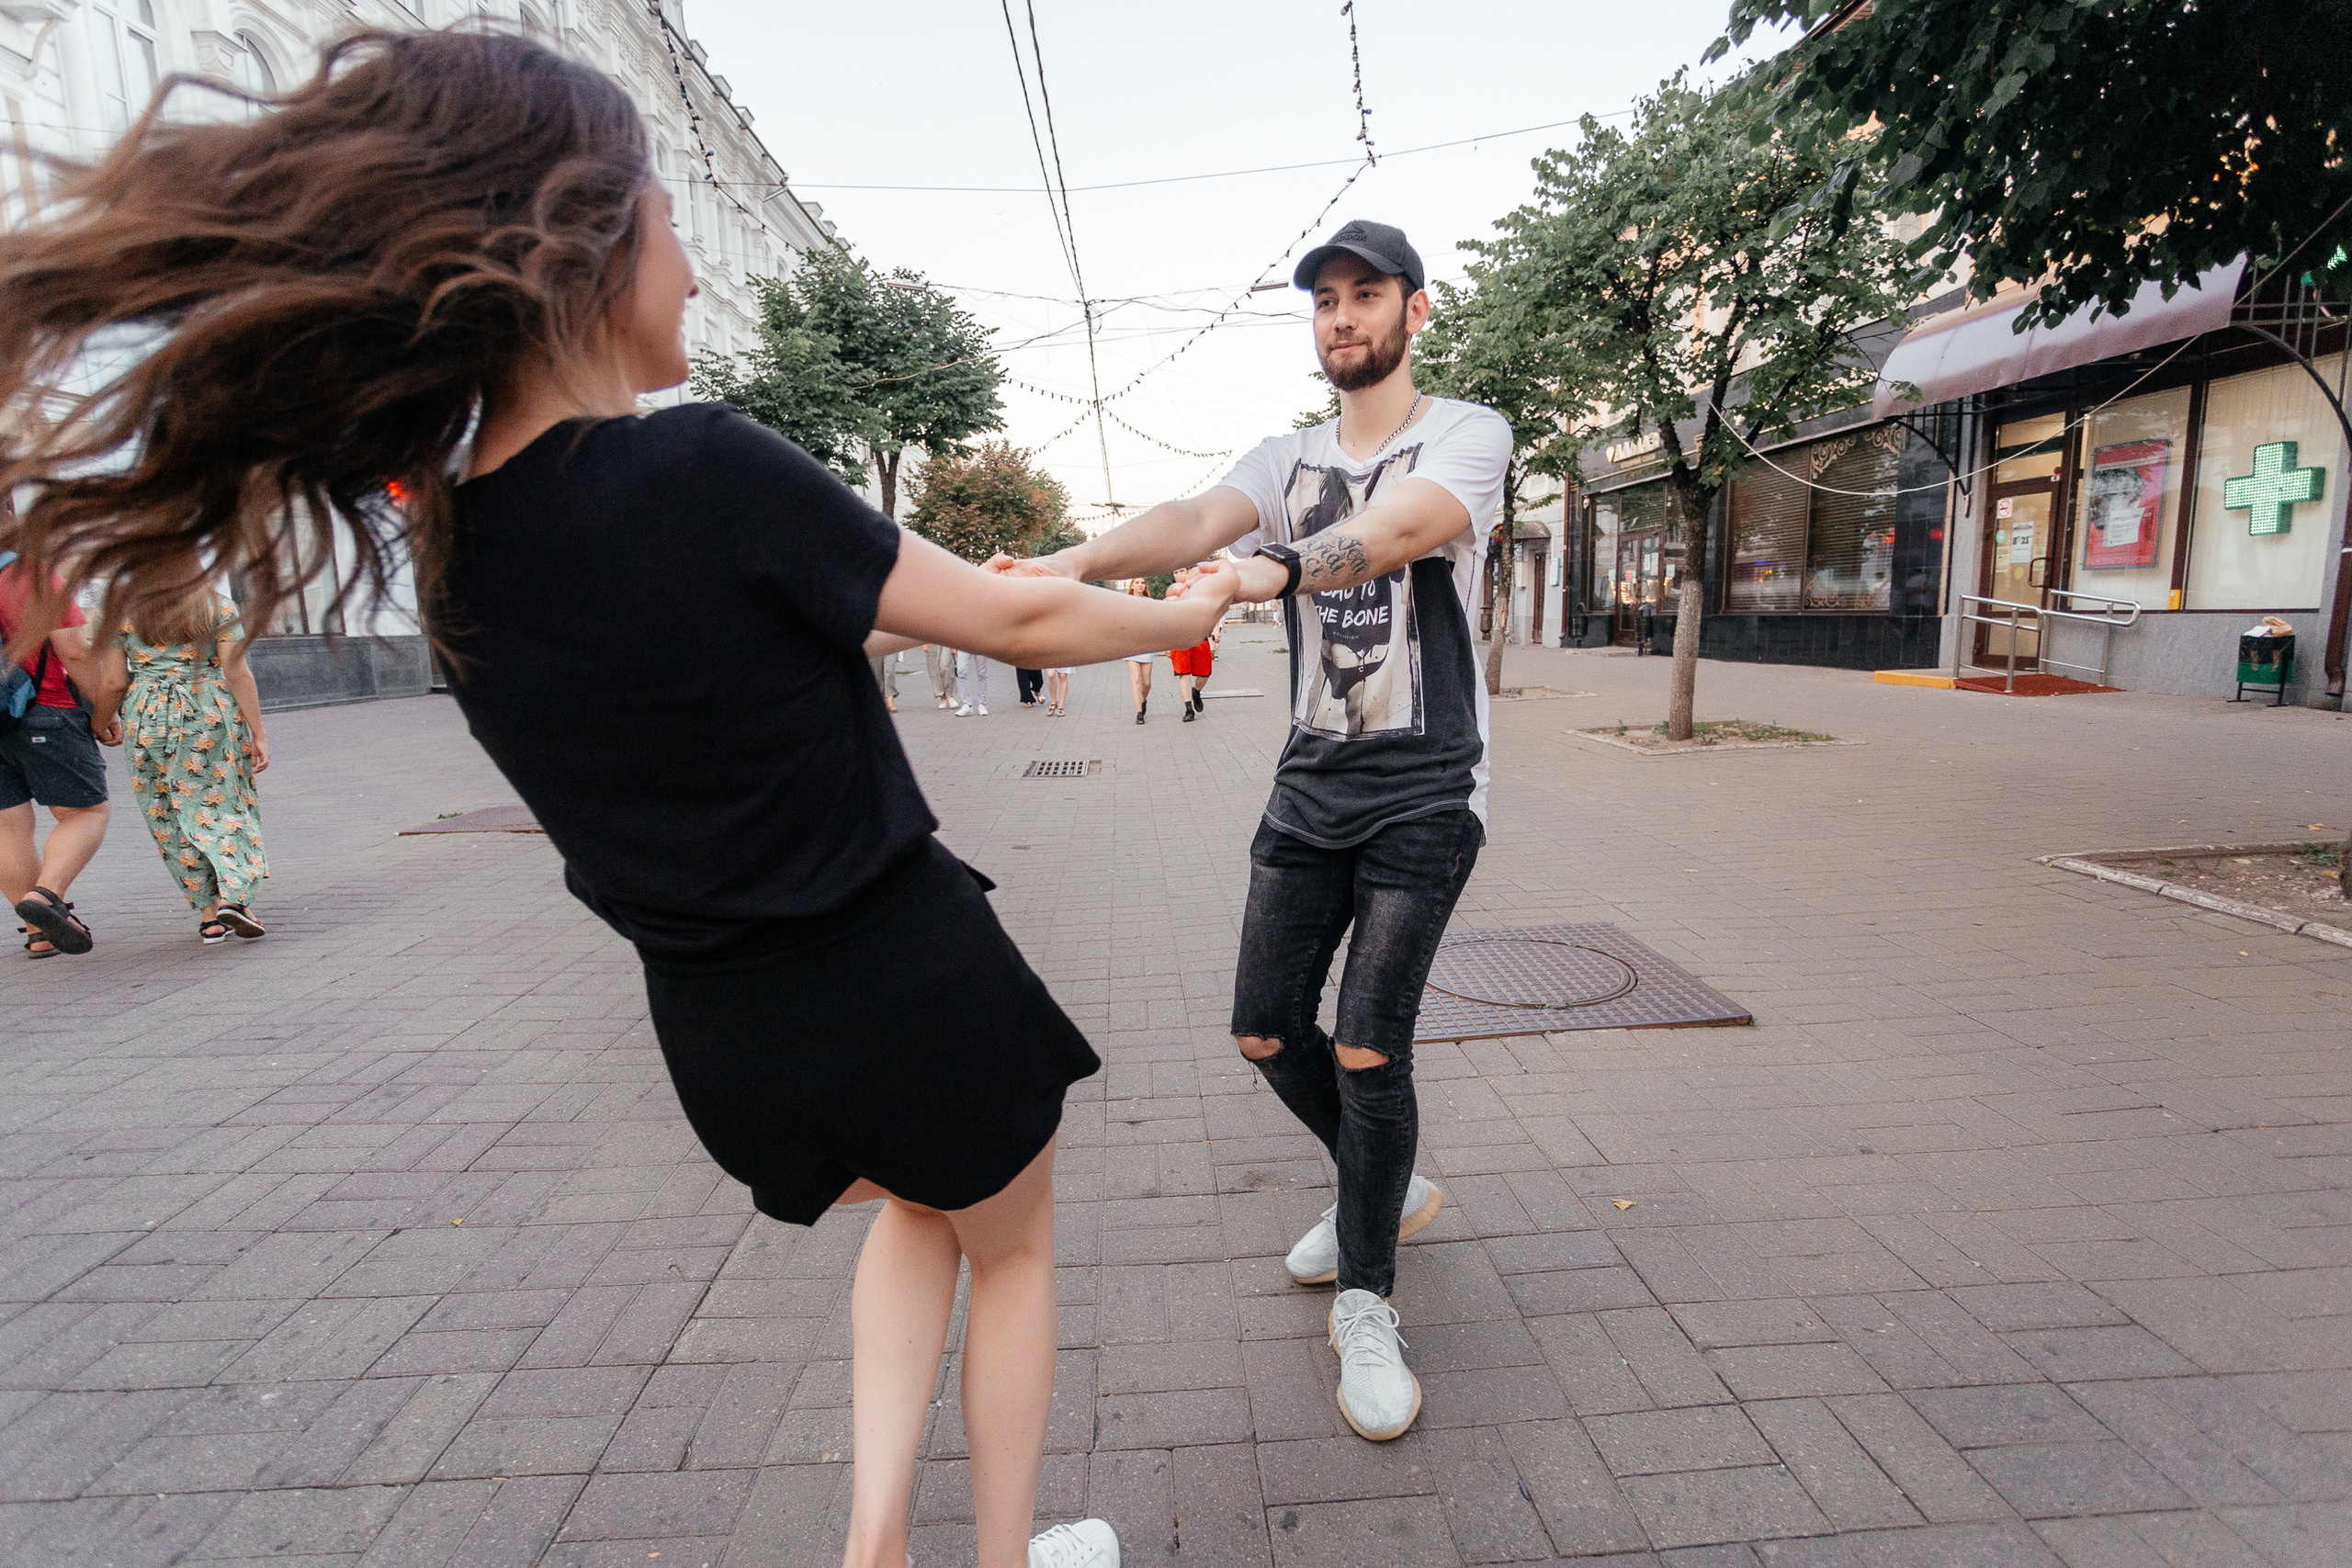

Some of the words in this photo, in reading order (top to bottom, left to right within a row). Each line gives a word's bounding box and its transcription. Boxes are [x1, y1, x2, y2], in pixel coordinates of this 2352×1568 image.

[1361, 580, 1376, 600] TO
[1315, 605, 1340, 624] HE
[1341, 605, 1389, 628] BONE
